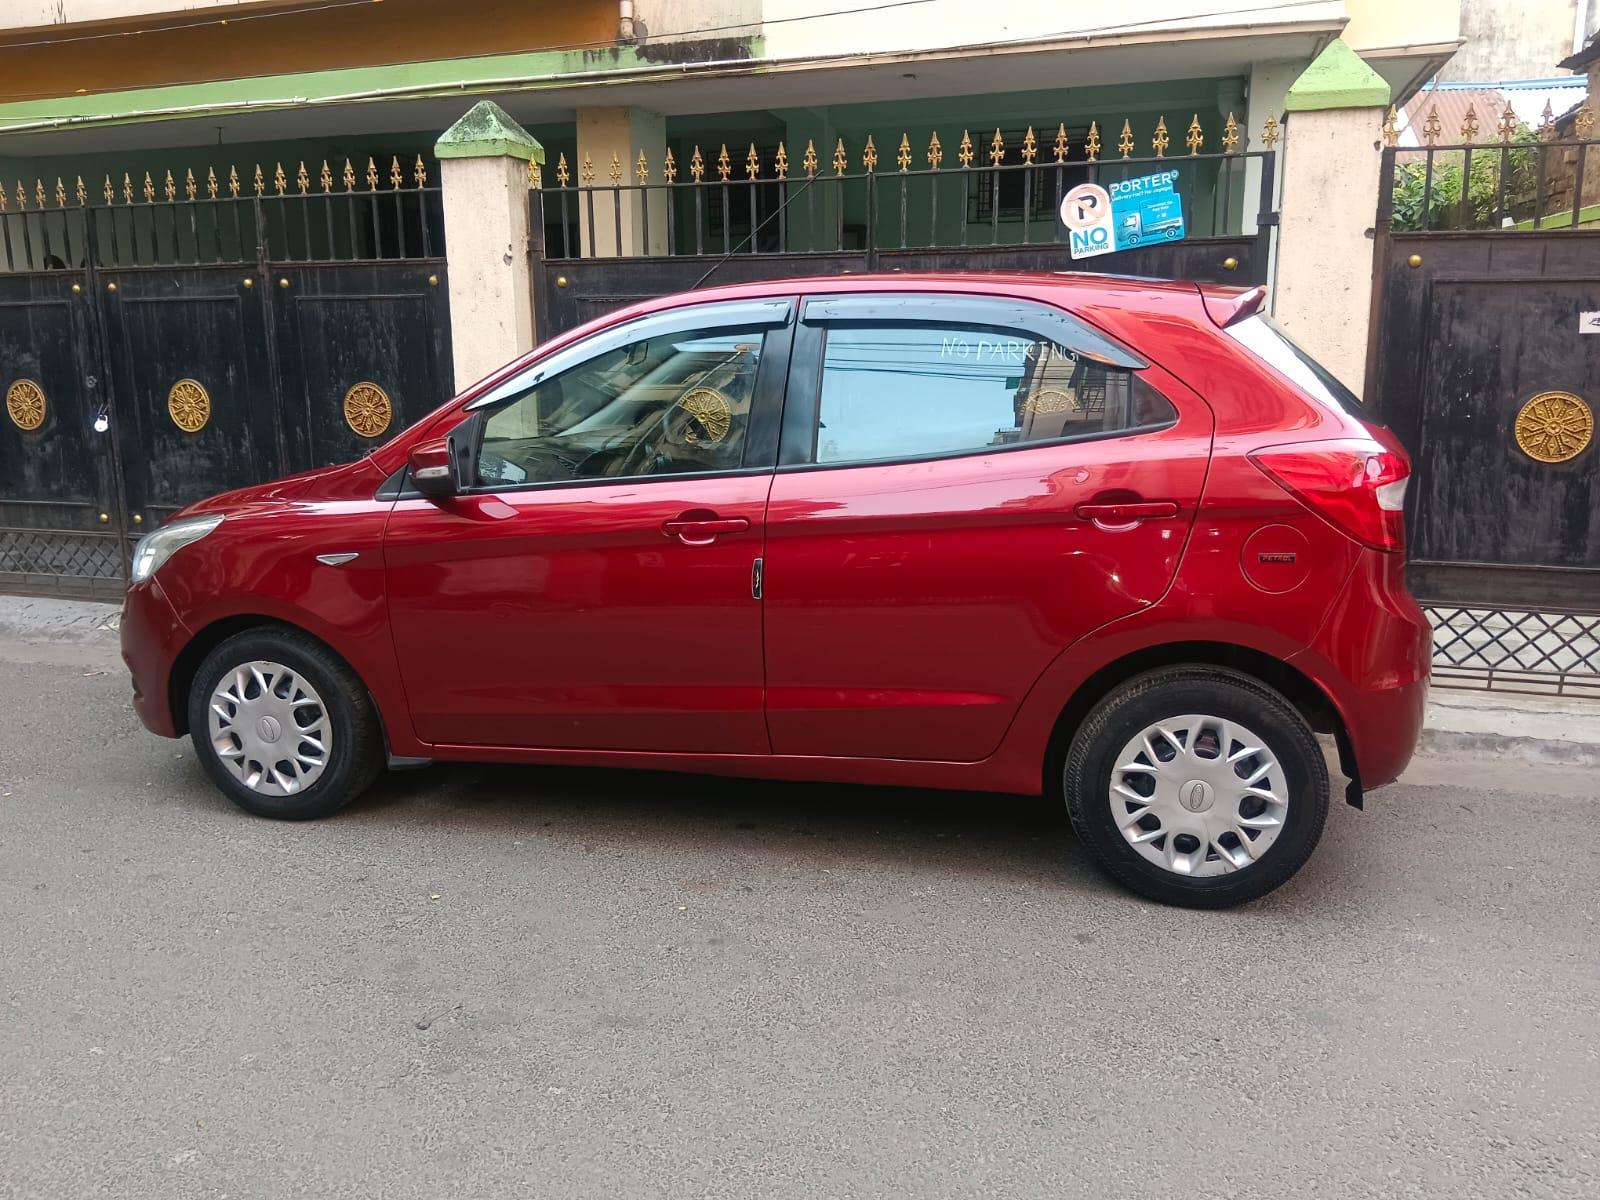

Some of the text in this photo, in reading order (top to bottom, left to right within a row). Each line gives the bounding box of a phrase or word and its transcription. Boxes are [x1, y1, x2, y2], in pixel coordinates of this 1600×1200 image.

[1110, 172, 1173, 196] PORTER
[1072, 227, 1108, 249] NO
[1073, 243, 1109, 255] PARKING
[941, 337, 969, 358] NO
